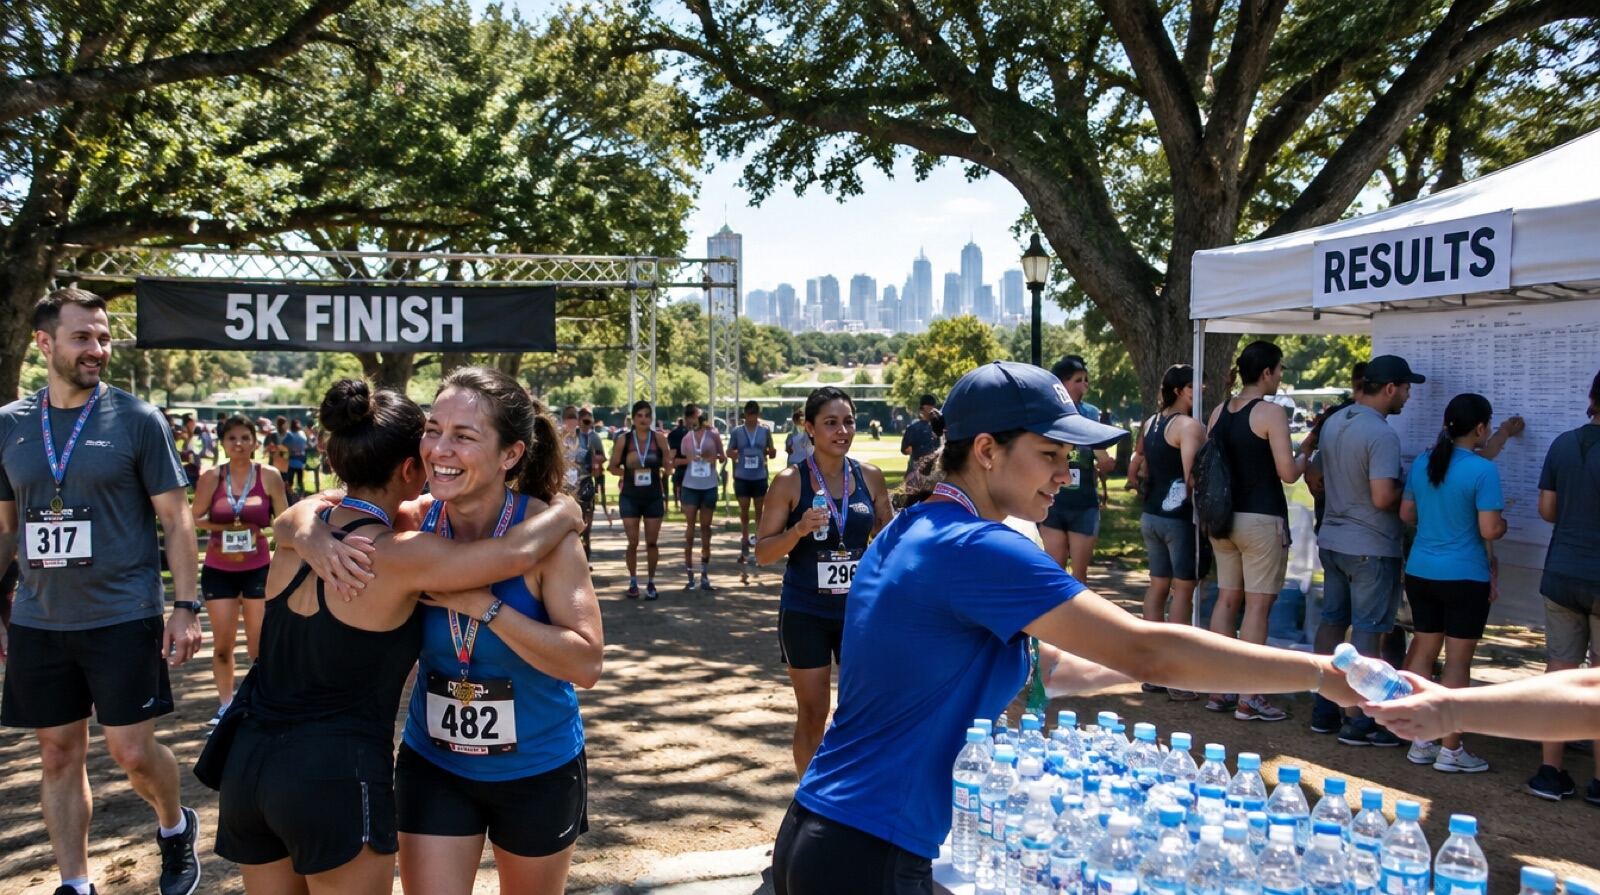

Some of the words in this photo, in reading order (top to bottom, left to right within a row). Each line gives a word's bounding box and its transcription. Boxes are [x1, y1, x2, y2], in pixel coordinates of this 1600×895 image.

[1324, 227, 1496, 294] RESULTS
[224, 293, 290, 341] 5K
[305, 295, 464, 343] FINISH
[37, 526, 78, 554] 317
[441, 703, 499, 740] 482
